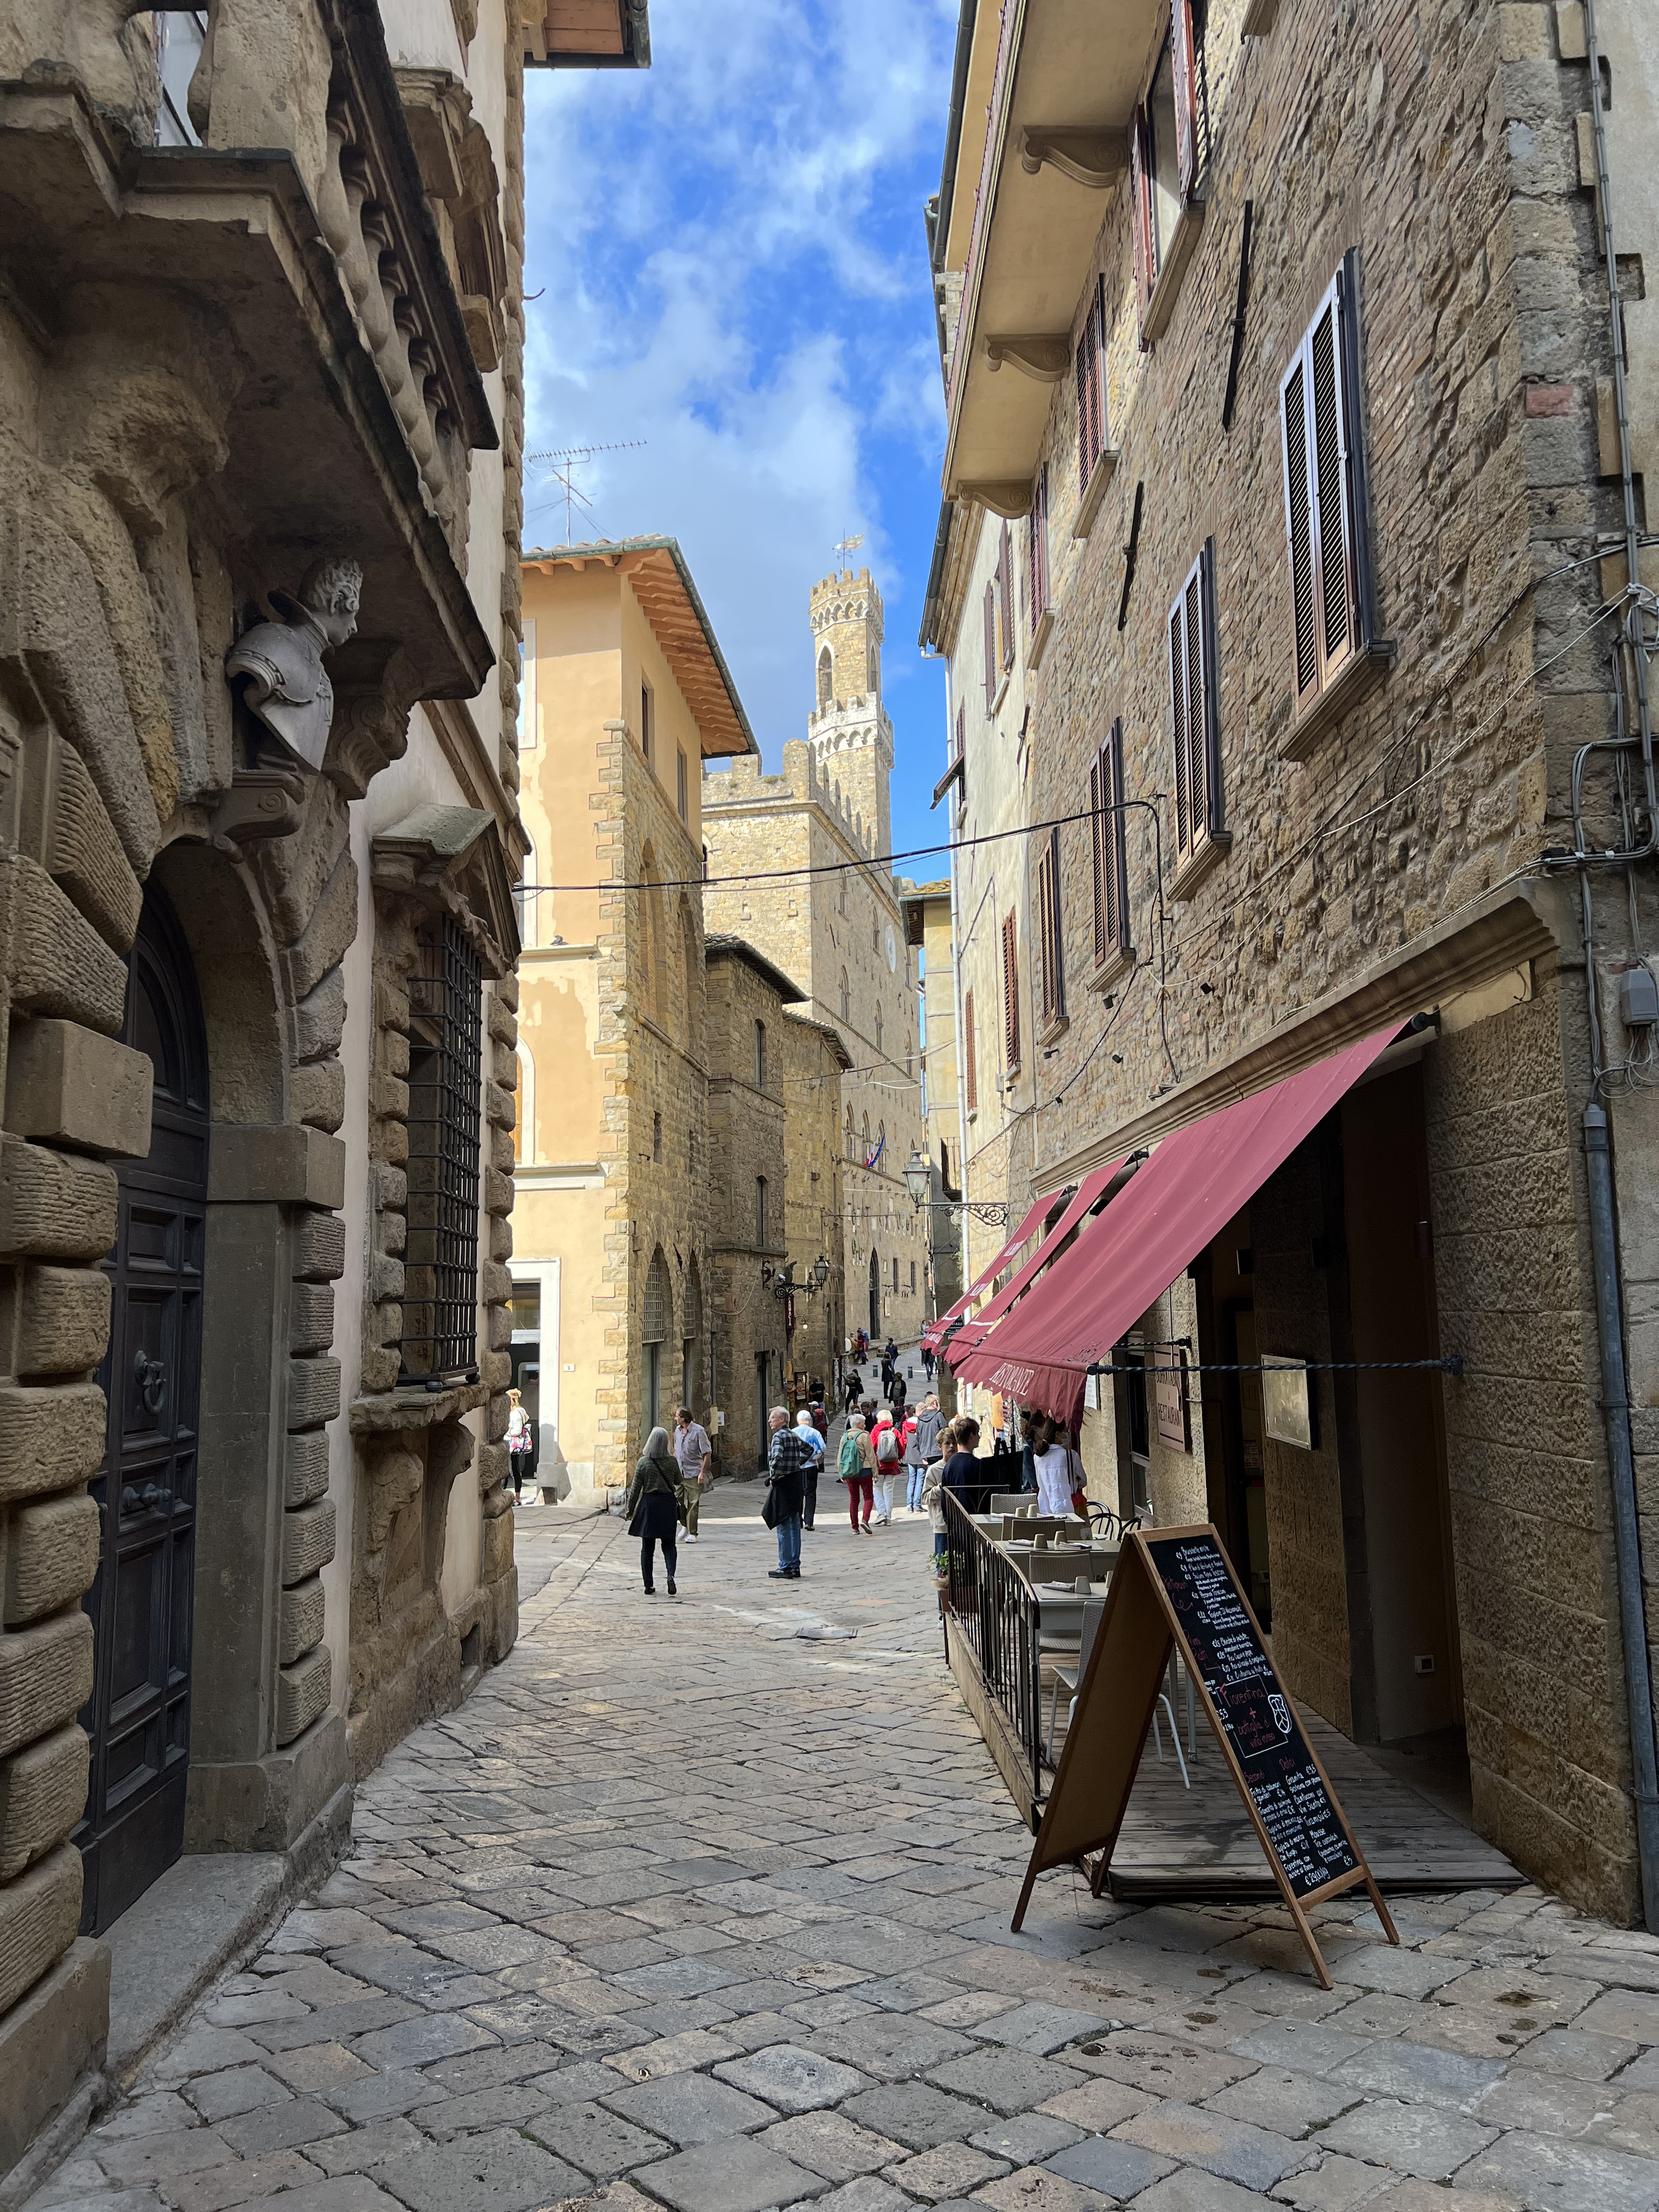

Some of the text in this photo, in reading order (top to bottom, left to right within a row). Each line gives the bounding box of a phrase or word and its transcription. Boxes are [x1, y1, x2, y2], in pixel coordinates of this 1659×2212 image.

[1219, 1683, 1265, 1707] Fiorentina
[1237, 1718, 1263, 1739] bottiglia
[1250, 1733, 1275, 1748] vino rosso
[1279, 1756, 1295, 1770] Dolci
[1286, 1771, 1304, 1785] Granita
[1307, 1799, 1321, 1811] Santo
[1310, 1828, 1326, 1840] Mousse
[1344, 1855, 1353, 1866] €5
